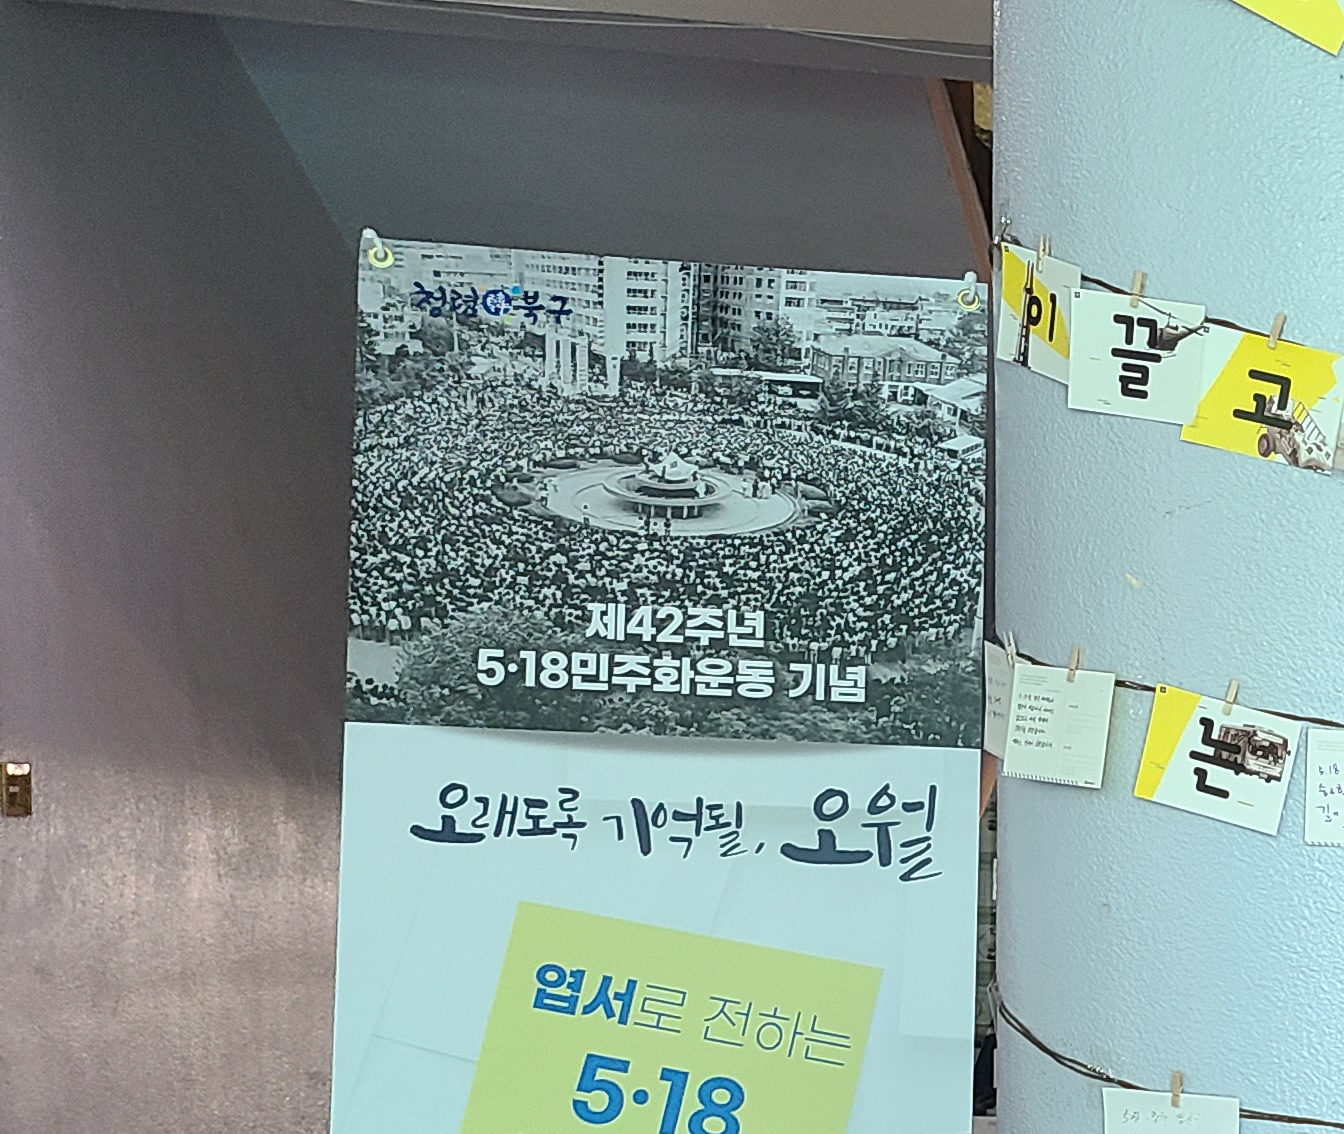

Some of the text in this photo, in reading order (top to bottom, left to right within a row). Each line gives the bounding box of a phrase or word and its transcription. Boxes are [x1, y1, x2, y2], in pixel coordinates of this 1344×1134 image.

[1109, 312, 1164, 401] 끌
[1232, 368, 1293, 432] 고
[585, 602, 766, 650] 제42주년
[476, 649, 868, 704] 5·18민주화운동 기념
[1189, 717, 1244, 799] 는
[409, 781, 943, 882] 오래도록 기억될, 오월
[532, 962, 852, 1066] 엽서로 전하는
